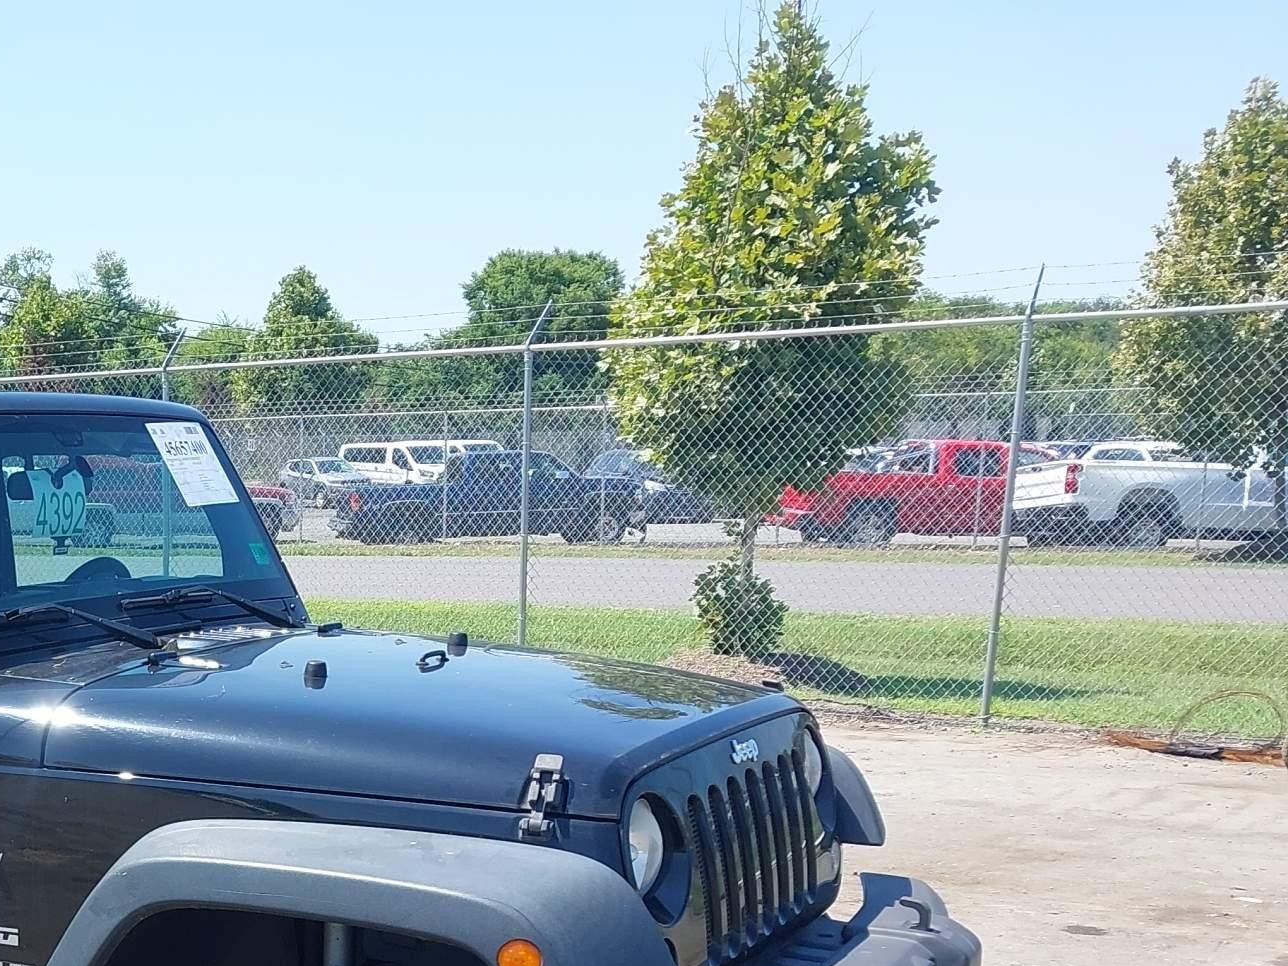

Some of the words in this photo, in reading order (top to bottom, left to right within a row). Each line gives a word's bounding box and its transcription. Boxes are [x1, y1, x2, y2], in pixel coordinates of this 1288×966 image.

[164, 440, 208, 456] 45657400
[35, 491, 86, 536] 4392
[729, 739, 759, 764] Jeep
